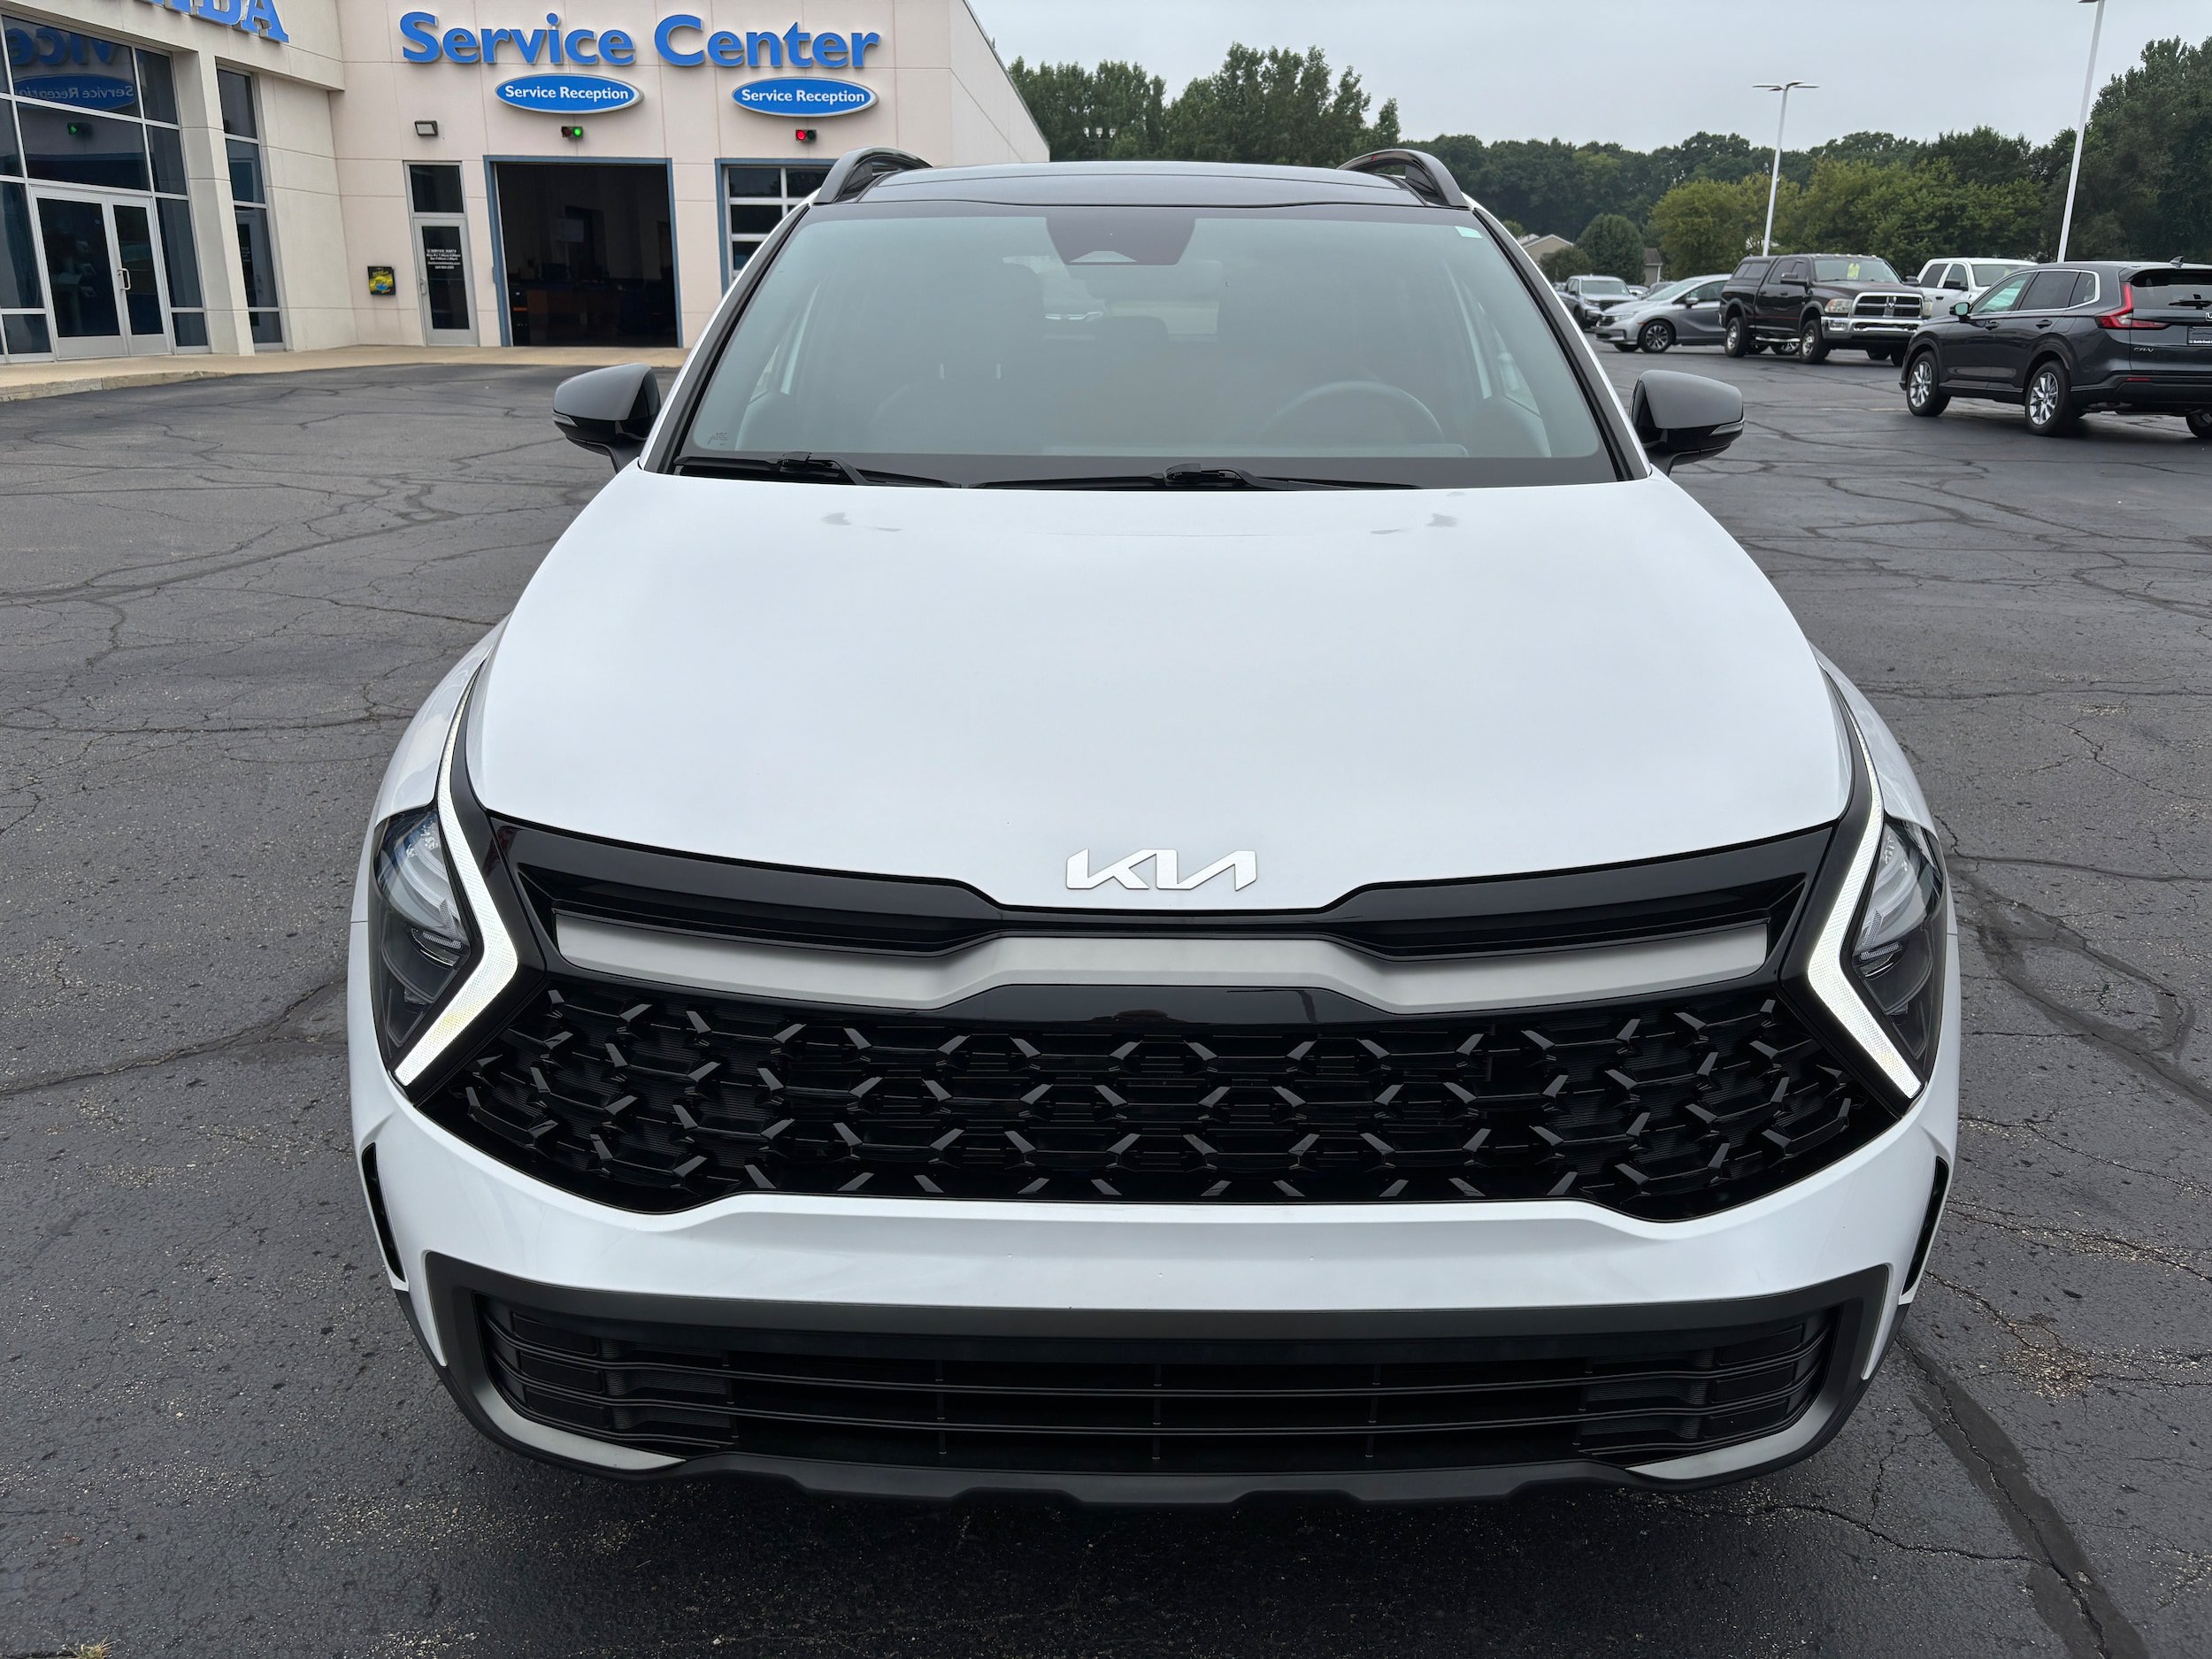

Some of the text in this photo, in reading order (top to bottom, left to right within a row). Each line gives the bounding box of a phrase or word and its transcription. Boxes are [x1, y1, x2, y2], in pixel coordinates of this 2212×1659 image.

[399, 11, 880, 69] Service Center
[505, 86, 629, 102] Service Reception
[741, 89, 864, 105] Service Reception
[1066, 849, 1257, 892] KIA
